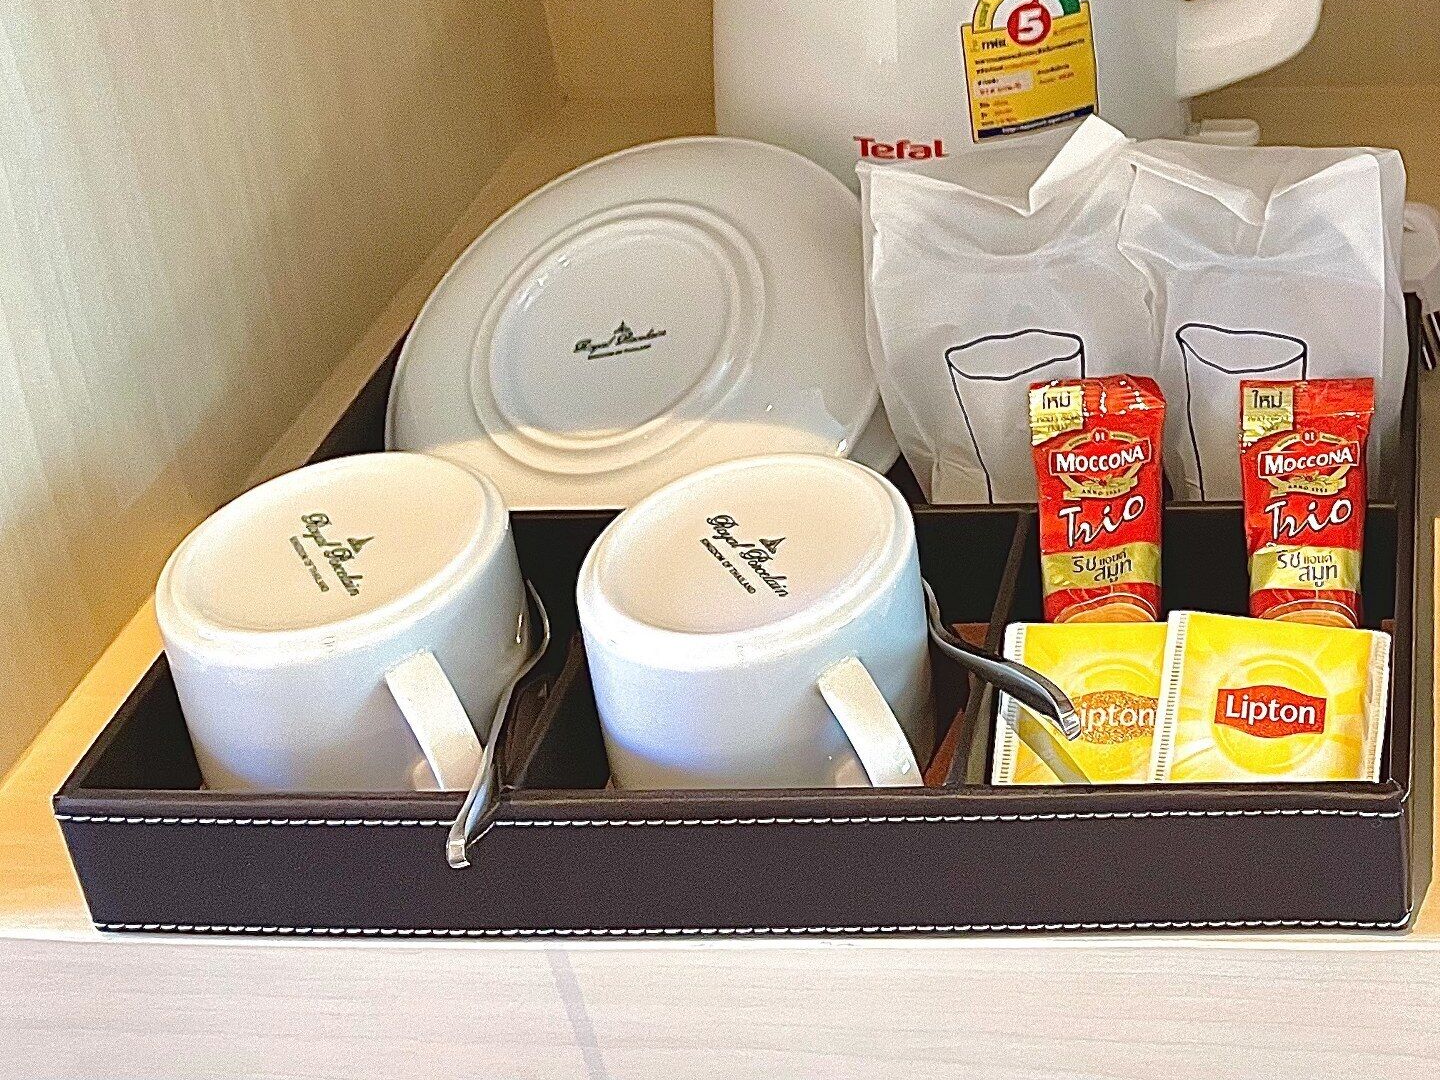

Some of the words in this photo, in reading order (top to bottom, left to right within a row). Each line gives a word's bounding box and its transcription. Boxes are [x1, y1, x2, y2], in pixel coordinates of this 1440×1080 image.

[1018, 6, 1045, 43] 5
[853, 135, 950, 161] Tefal
[1251, 388, 1283, 410] ใหม่
[1056, 445, 1146, 474] MOCCONA
[1264, 446, 1354, 476] MOCCONA
[1059, 495, 1145, 548] Trio
[1265, 497, 1353, 541] Trio
[301, 512, 343, 548] Royal
[323, 547, 364, 597] Porcelain
[706, 514, 756, 549] Royal
[739, 548, 789, 598] Porcelain
[1094, 557, 1133, 583] สมูท
[1298, 563, 1338, 588] สมูท
[1080, 703, 1158, 730] ipton
[1225, 693, 1316, 725] Lipton
